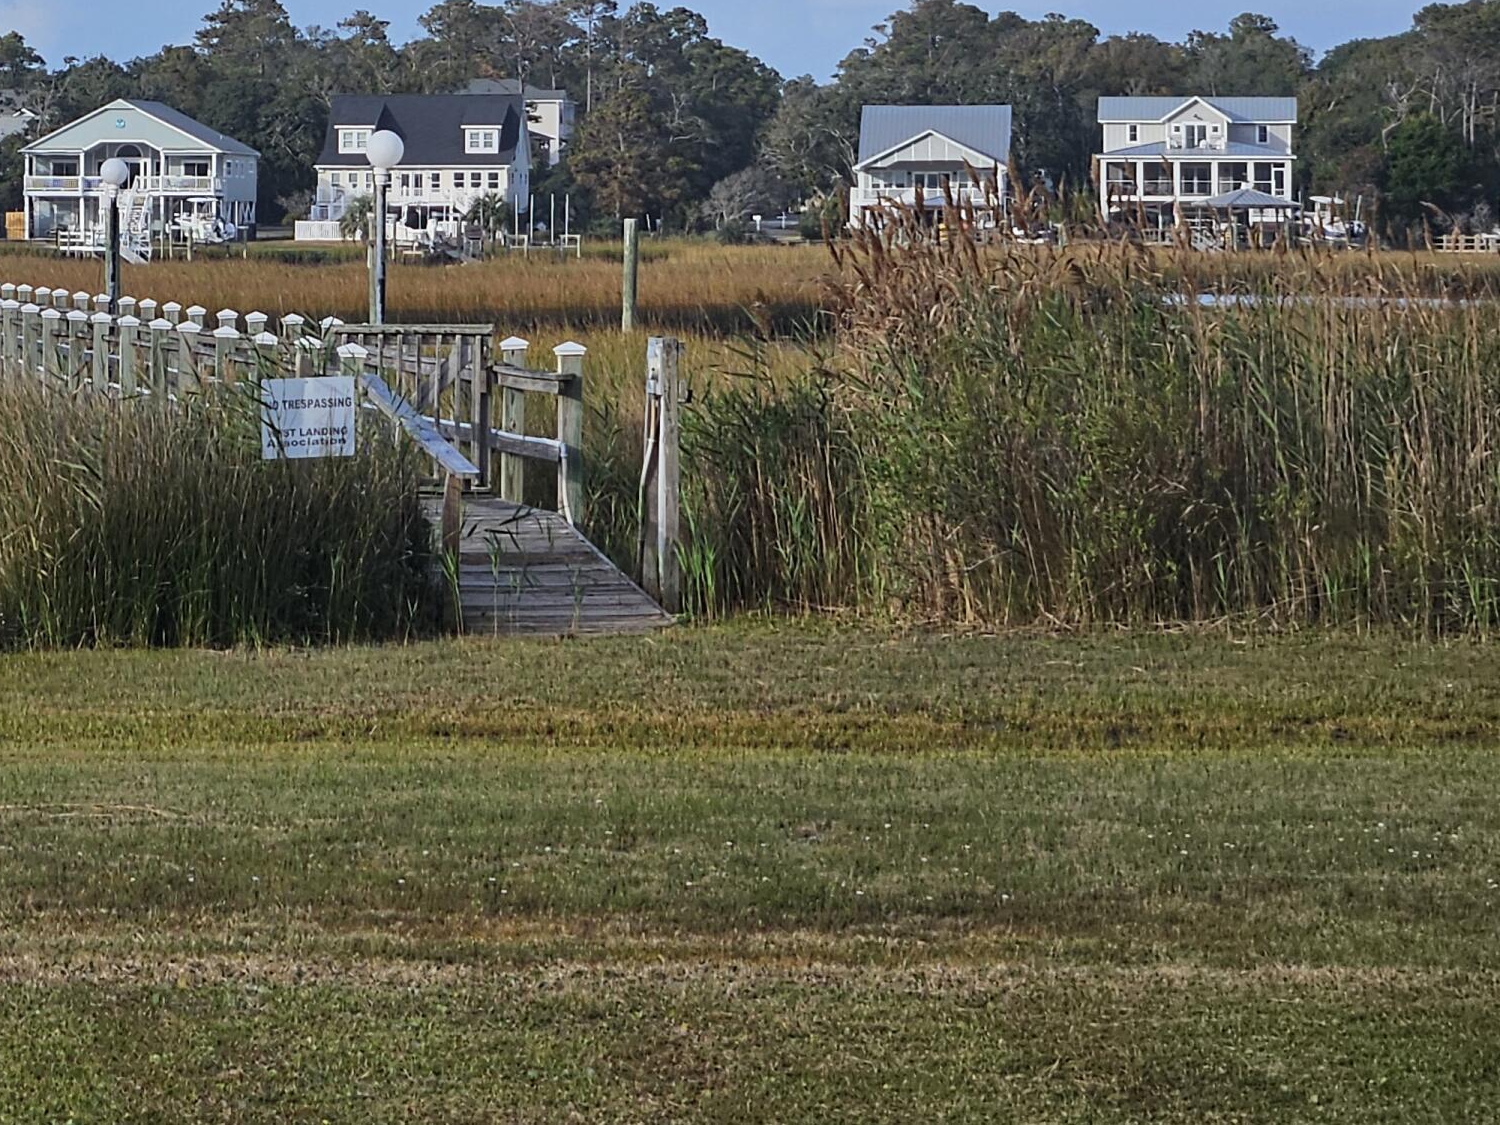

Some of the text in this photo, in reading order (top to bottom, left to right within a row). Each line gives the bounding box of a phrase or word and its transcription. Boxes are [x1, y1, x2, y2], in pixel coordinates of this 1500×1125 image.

[282, 397, 352, 410] TRESPASSING
[267, 426, 348, 438] ST LANDING
[267, 437, 347, 448] Asociation
